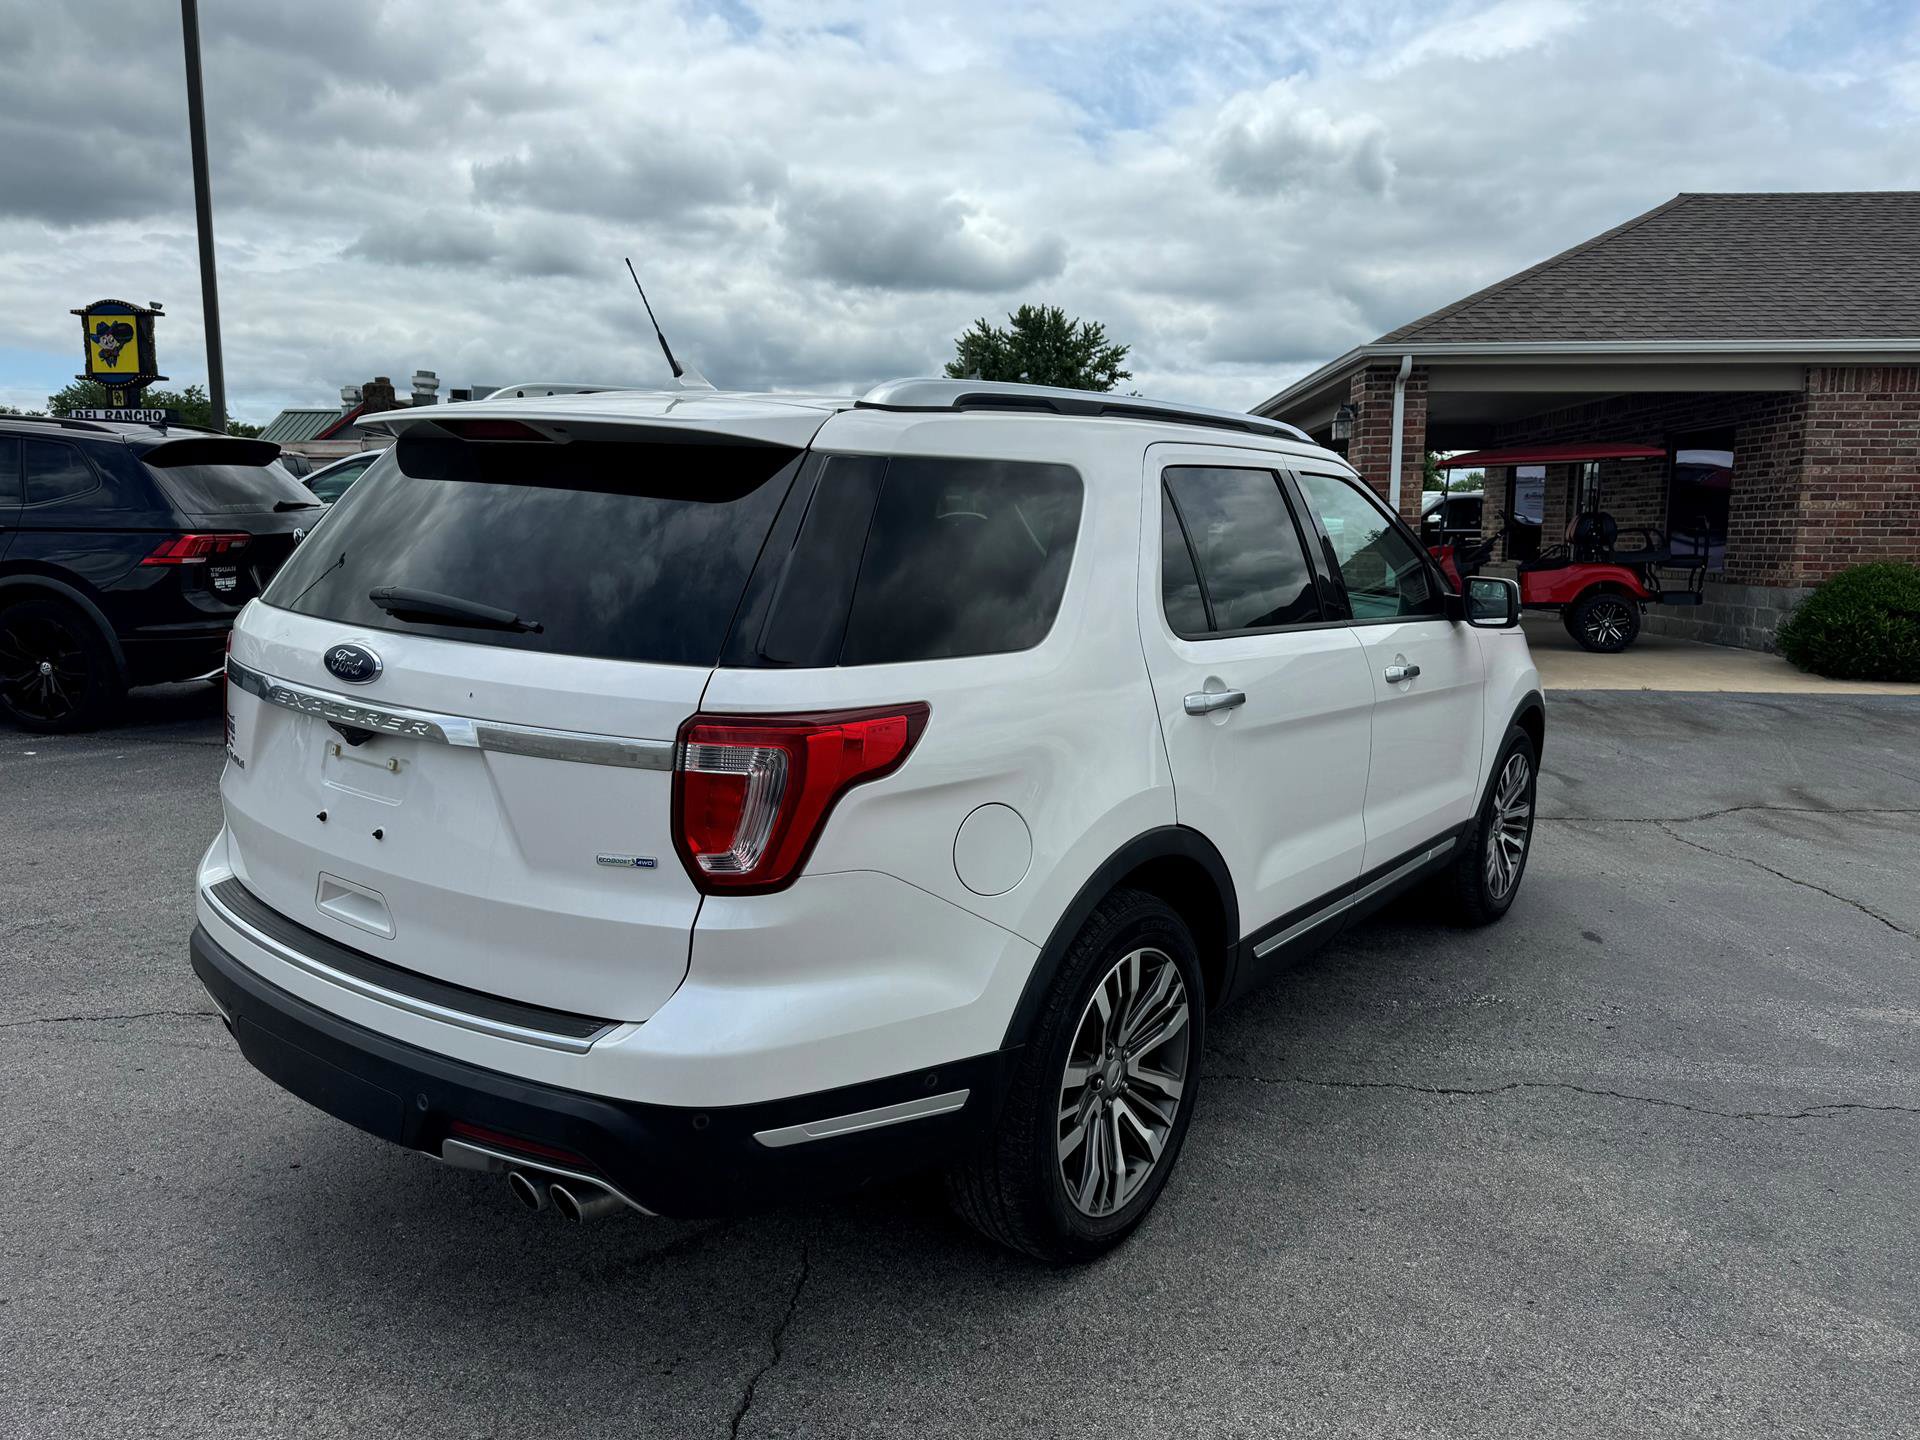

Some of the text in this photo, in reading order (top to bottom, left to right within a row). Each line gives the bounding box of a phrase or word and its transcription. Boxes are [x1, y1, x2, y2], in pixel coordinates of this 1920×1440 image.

[104, 410, 162, 421] RANCHO
[330, 649, 363, 675] Ford
[274, 690, 430, 735] EXPLORER
